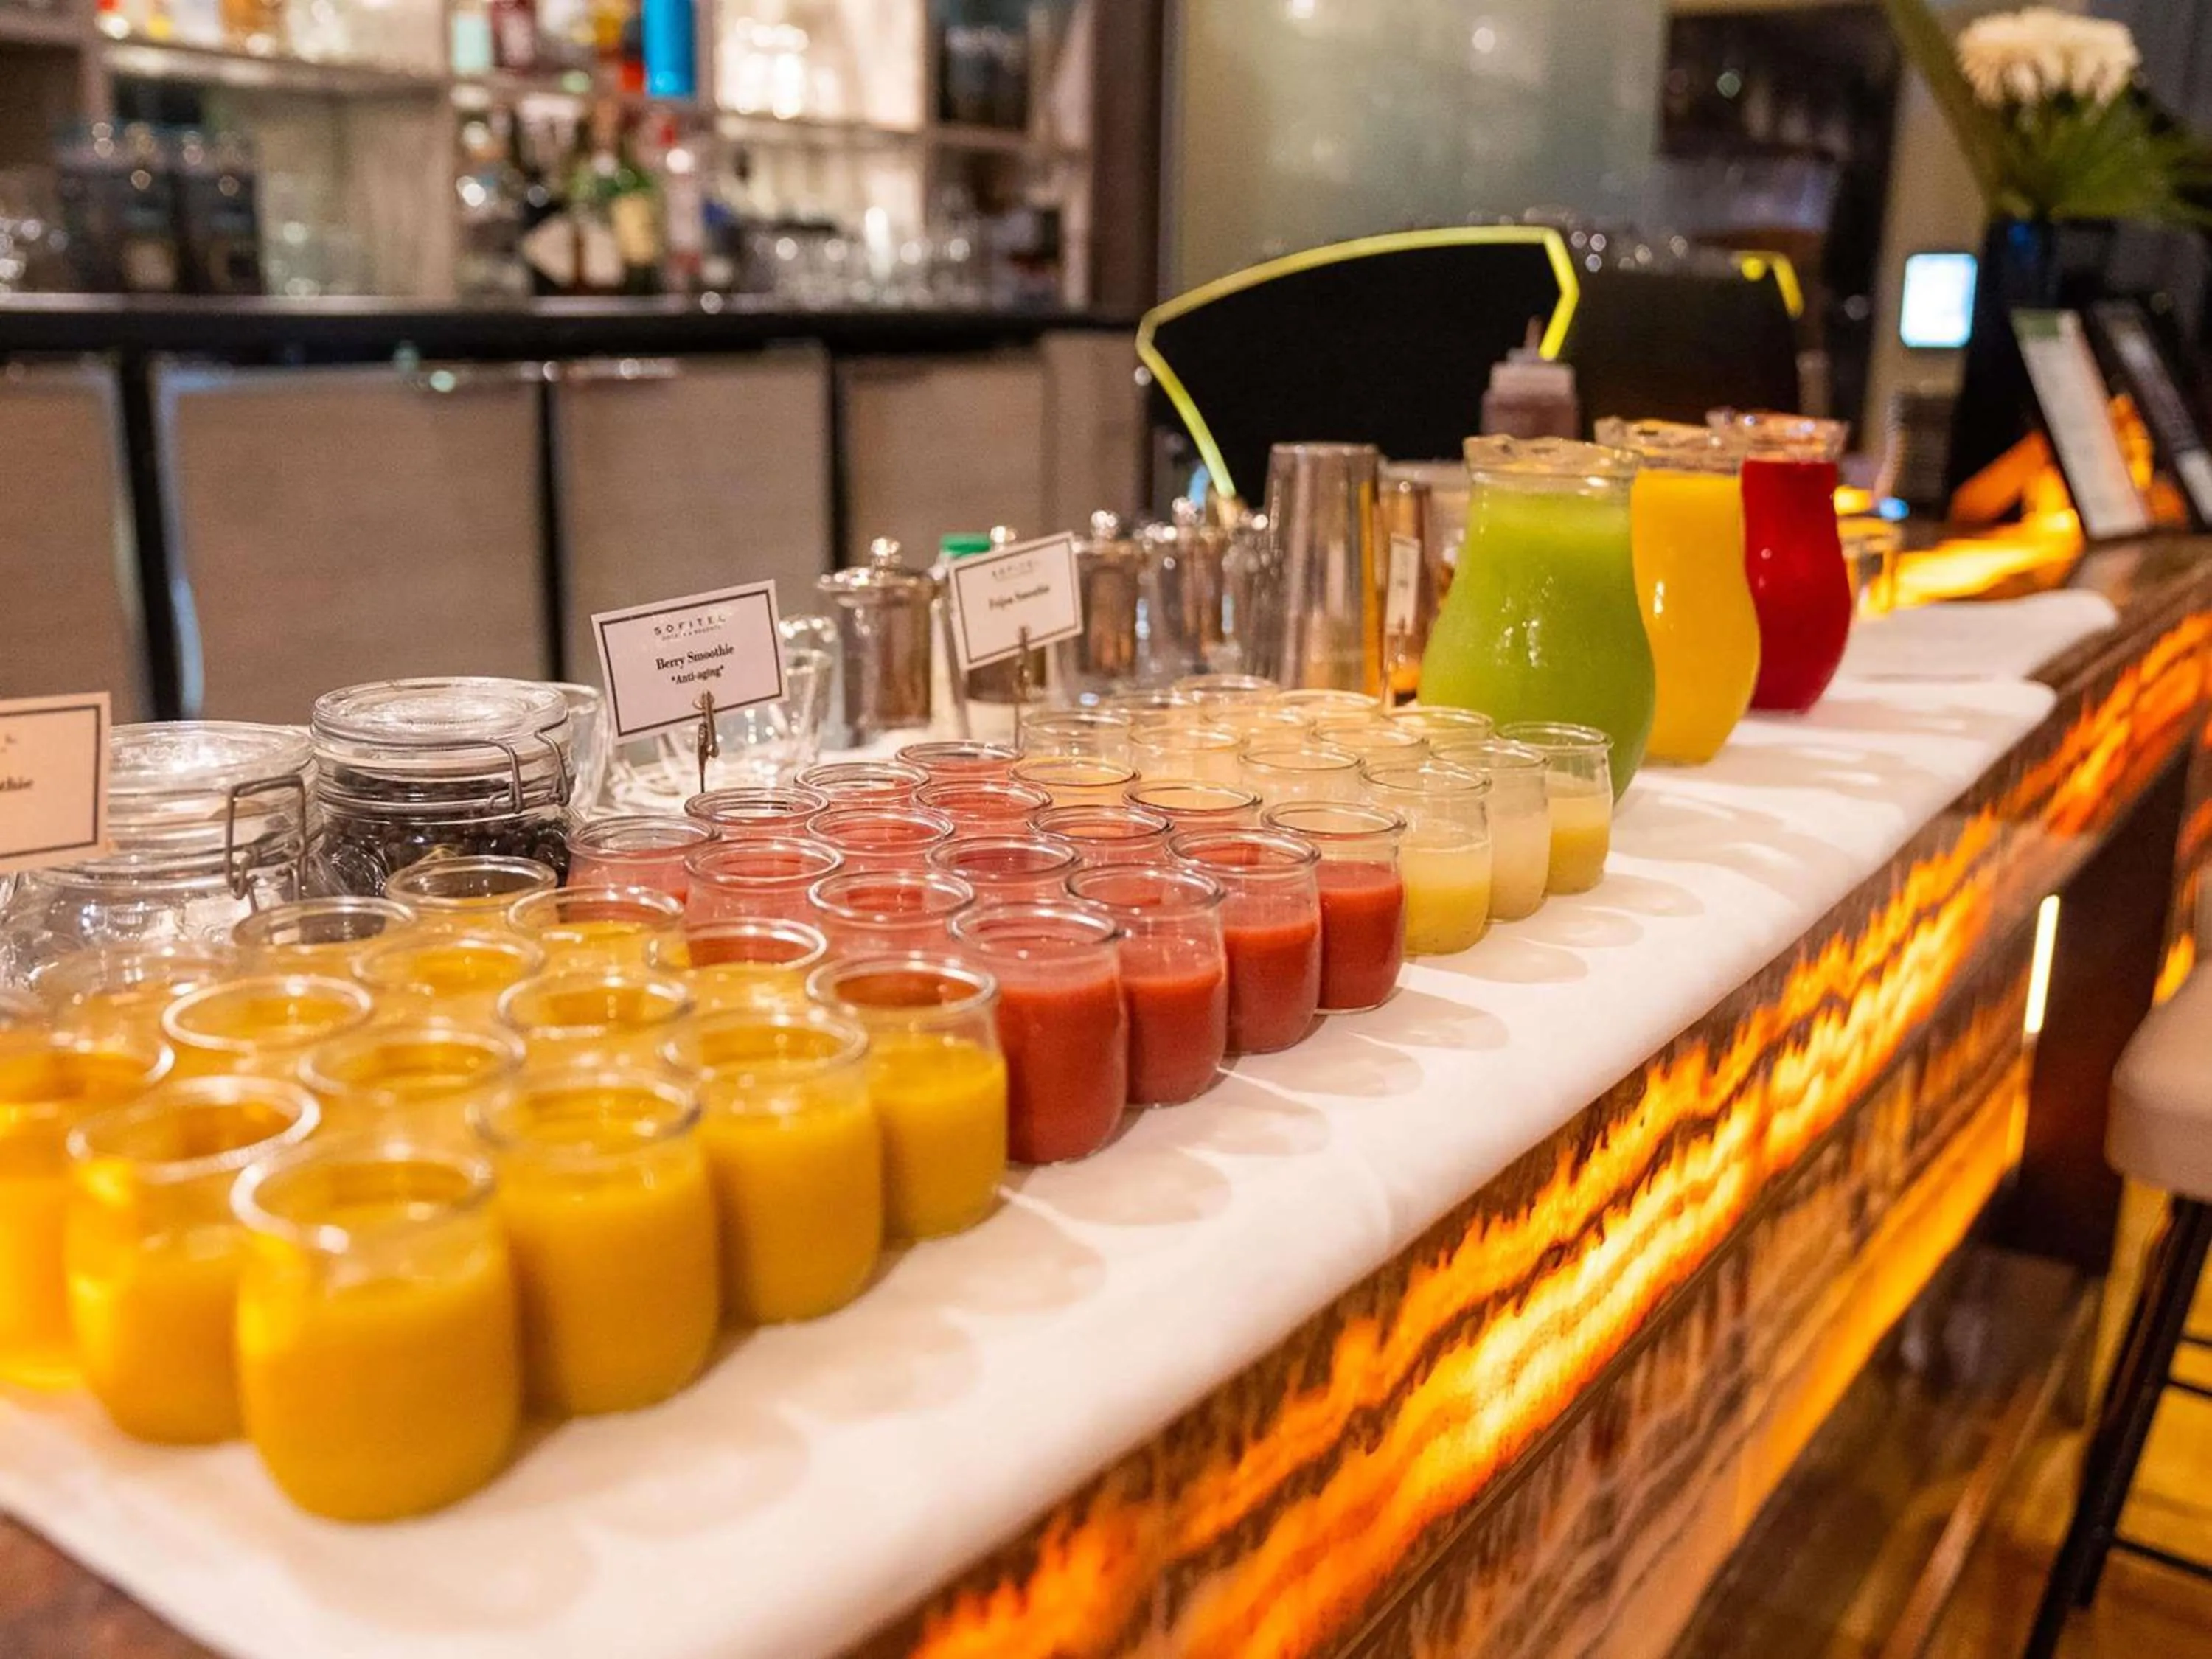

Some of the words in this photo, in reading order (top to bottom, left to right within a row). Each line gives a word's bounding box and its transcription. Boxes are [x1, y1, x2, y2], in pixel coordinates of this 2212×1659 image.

[653, 616, 726, 636] SOFITEL
[655, 657, 686, 670] Berry
[686, 643, 734, 663] Smoothie
